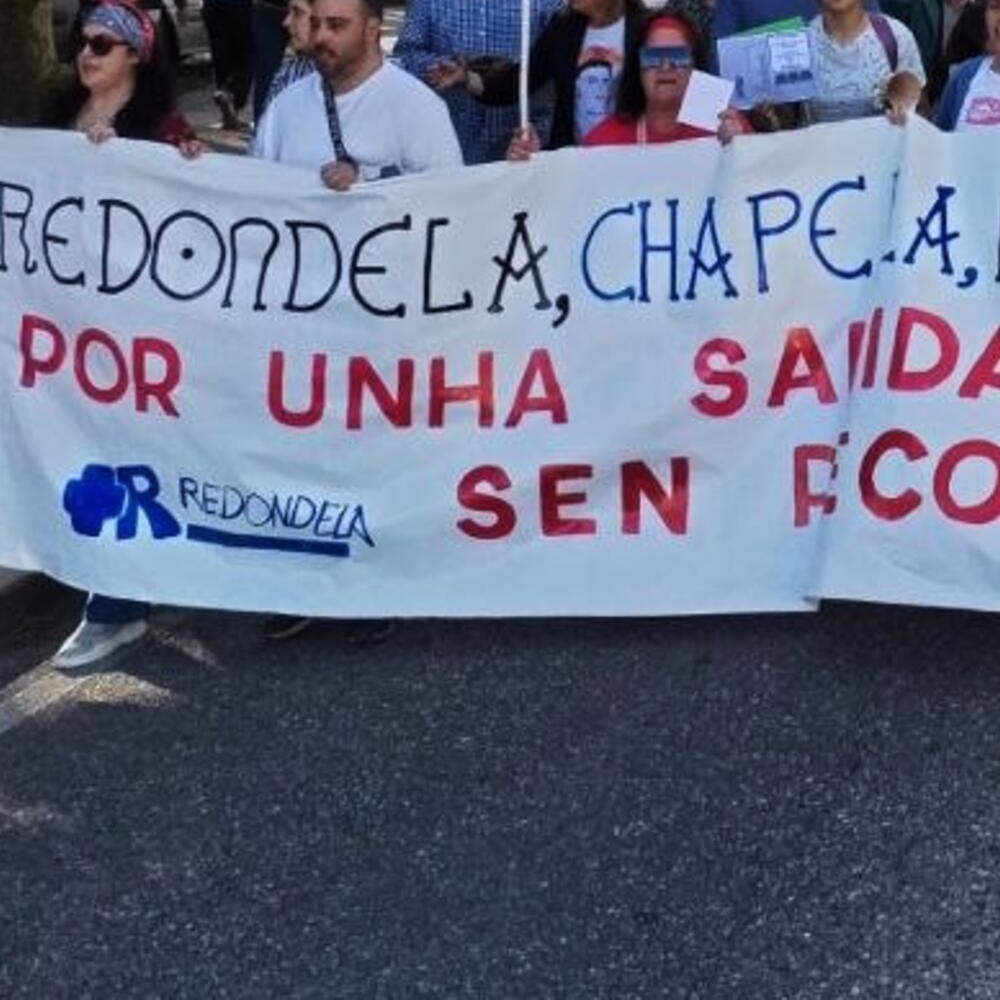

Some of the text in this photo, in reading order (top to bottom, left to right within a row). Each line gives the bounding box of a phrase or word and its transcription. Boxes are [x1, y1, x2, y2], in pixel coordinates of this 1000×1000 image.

[0, 180, 571, 328] REDONDELA,
[581, 172, 979, 302] CHAPEA,
[19, 313, 182, 419] POR
[266, 349, 568, 432] UNHA
[178, 476, 376, 548] REDONDELA
[456, 456, 691, 540] SEN
